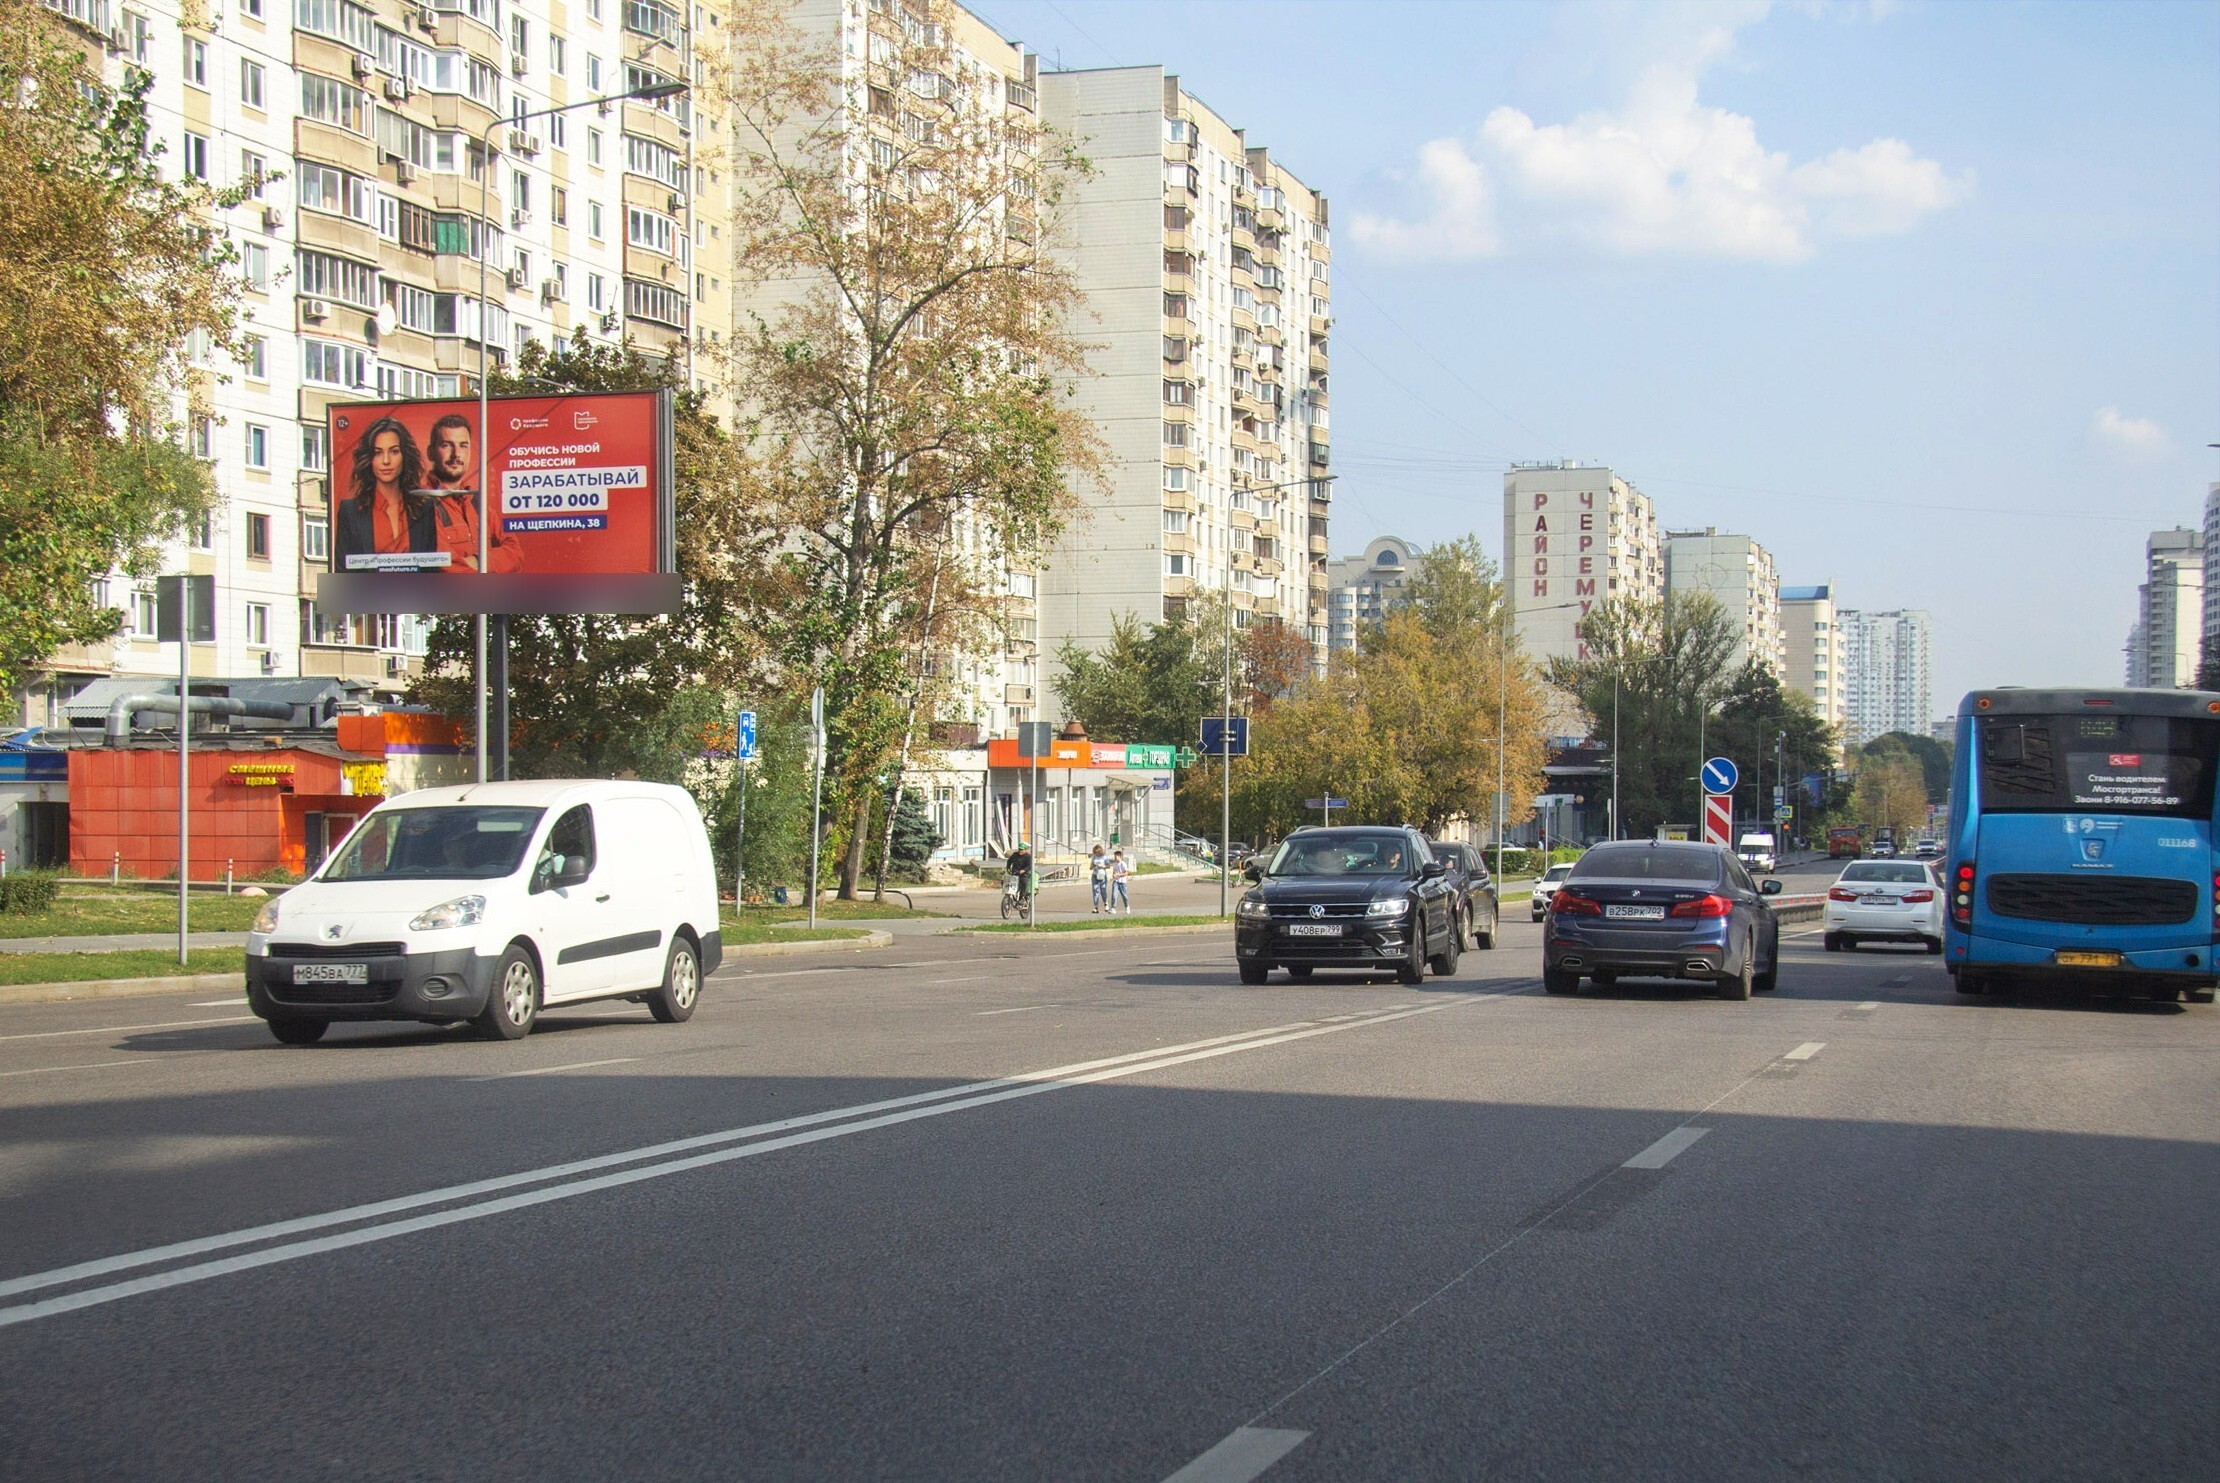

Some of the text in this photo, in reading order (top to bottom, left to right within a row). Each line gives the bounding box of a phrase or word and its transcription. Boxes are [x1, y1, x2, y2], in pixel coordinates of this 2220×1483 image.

[338, 419, 349, 428] 12+
[509, 442, 600, 456] ОБУЧИСЬ НОВОЙ
[509, 457, 576, 468] ПРОФЕССИИ
[509, 468, 639, 489] ЗАРАБАТЫВАЙ
[509, 493, 600, 509] ОТ 120 000
[509, 518, 601, 531] НА ЩЕПКИНА, 38
[1533, 492, 1548, 598] РАЙОН
[348, 557, 368, 565] Центр
[228, 764, 295, 774] СМЕШНЫЕ
[245, 776, 277, 787] ЦЕНЫ
[2088, 774, 2166, 784] Стань водителем
[2092, 785, 2162, 795] Мосгортранса!
[2074, 795, 2179, 805] Звони 8-916-077-56-89
